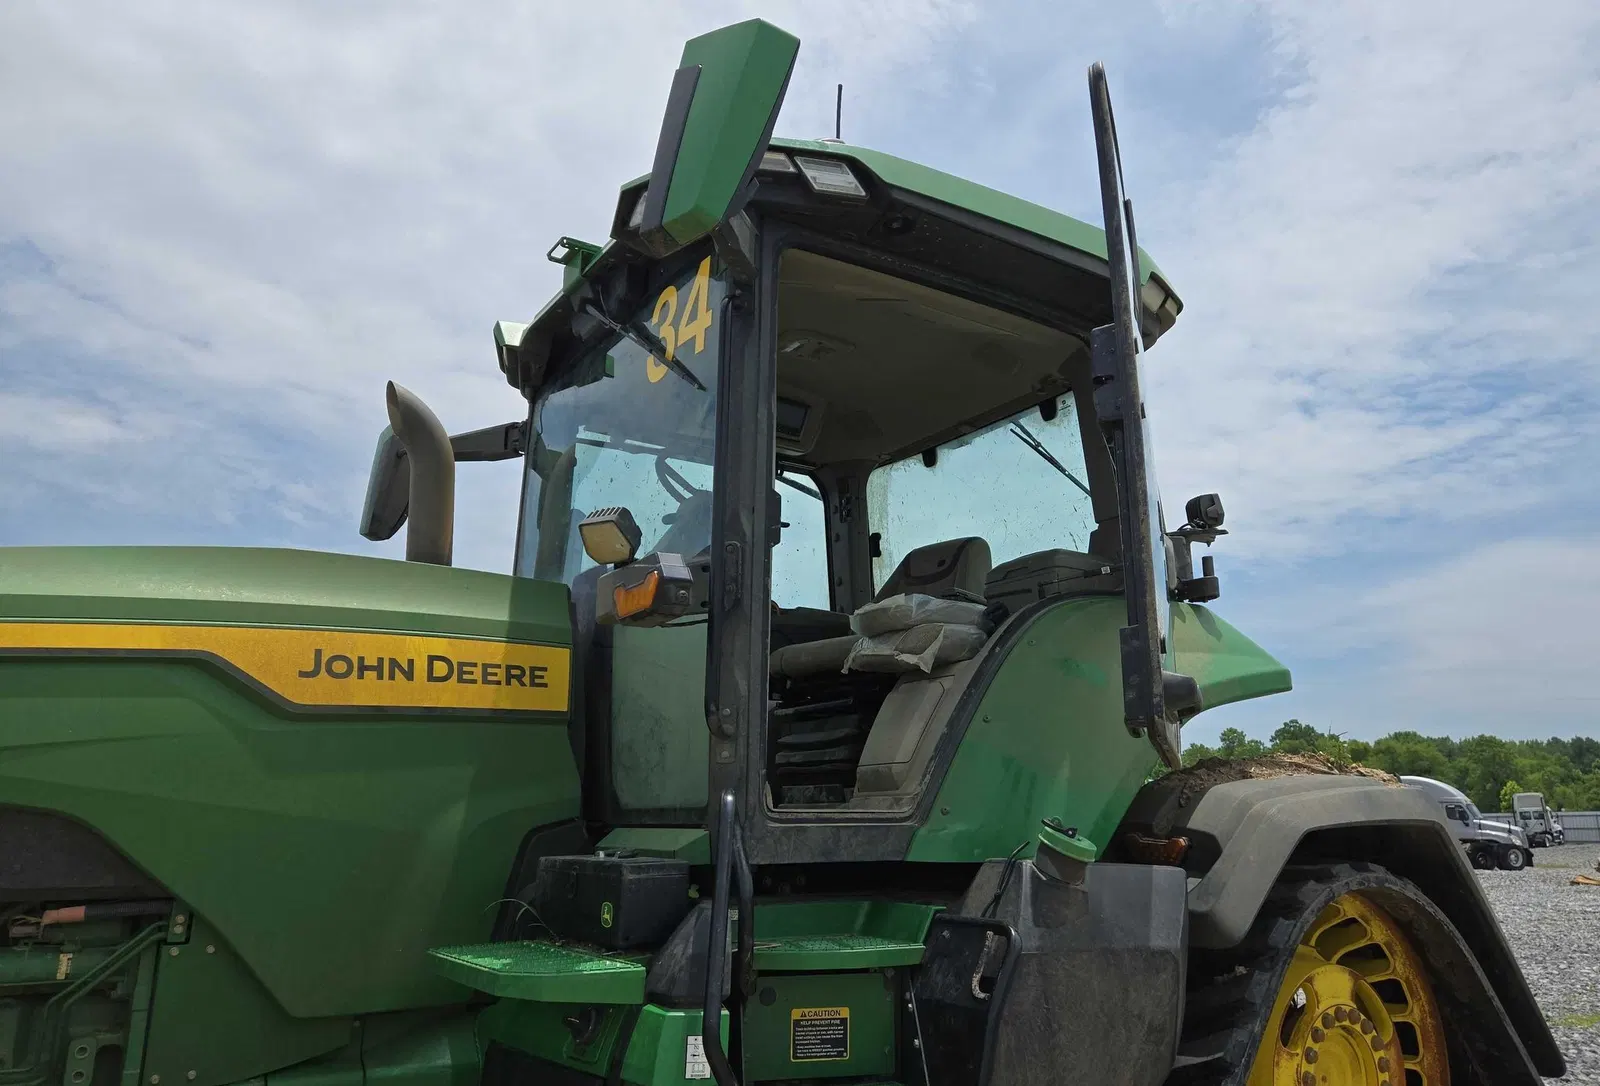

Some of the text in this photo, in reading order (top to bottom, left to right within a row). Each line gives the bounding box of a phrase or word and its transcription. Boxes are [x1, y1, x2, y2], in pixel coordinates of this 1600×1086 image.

[646, 255, 713, 383] 34
[298, 648, 549, 688] JOHN DEERE
[807, 1009, 841, 1018] CAUTION
